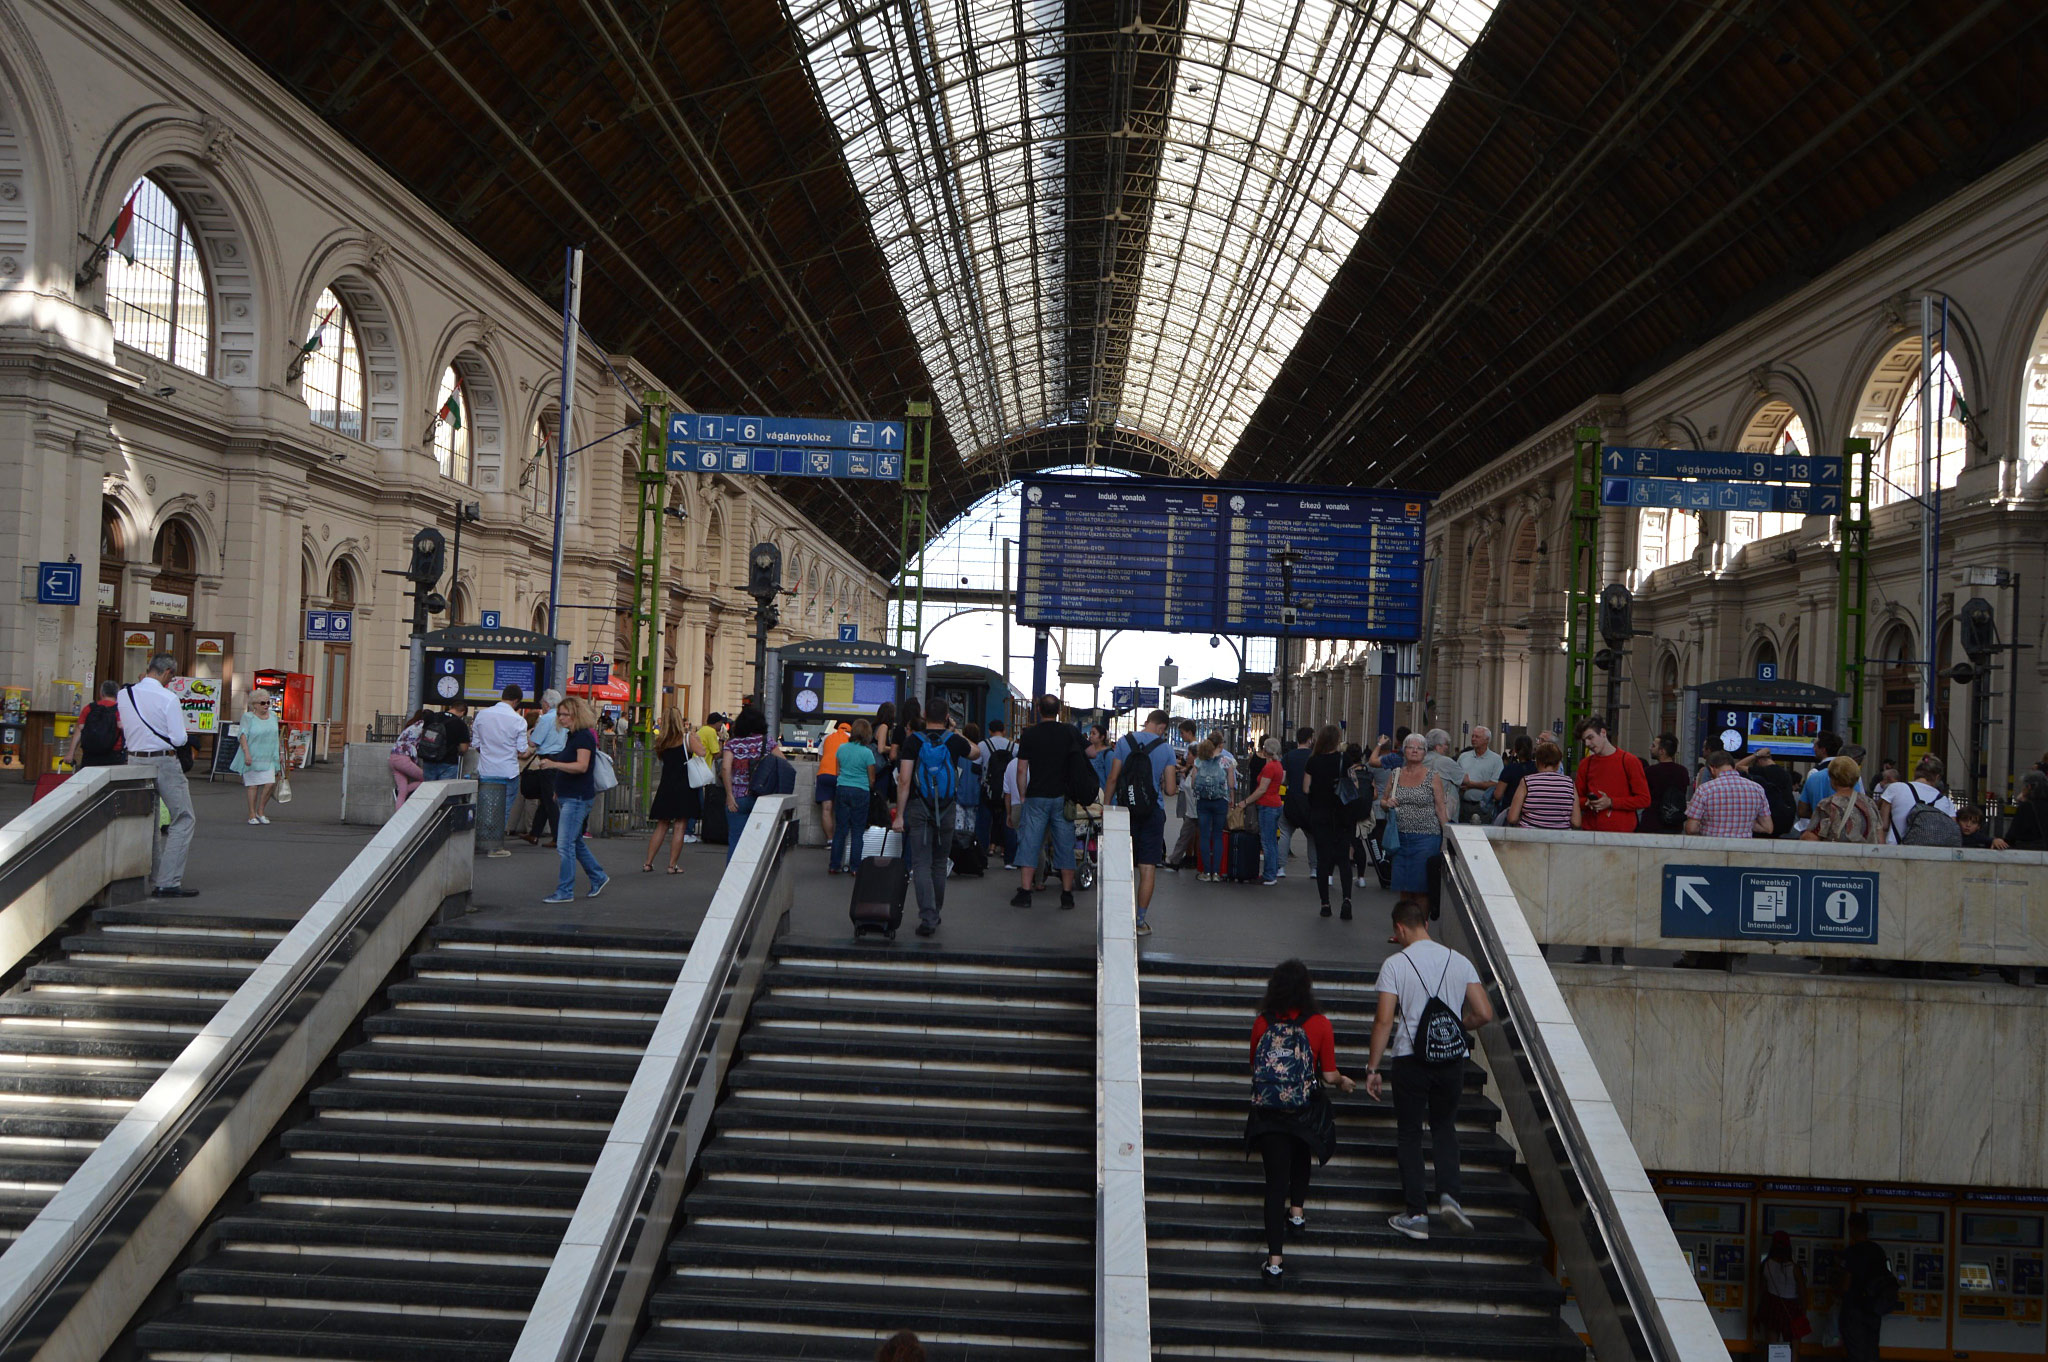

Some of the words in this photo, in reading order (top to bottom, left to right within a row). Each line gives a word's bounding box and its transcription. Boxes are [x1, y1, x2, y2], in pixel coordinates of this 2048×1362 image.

[706, 423, 714, 437] 1
[744, 425, 756, 439] 6
[766, 431, 832, 443] vágányokhoz
[1676, 465, 1743, 476] vágányokhoz
[1753, 462, 1764, 476] 9
[1789, 464, 1808, 478] 13
[1098, 492, 1118, 500] Induló
[1122, 494, 1146, 502] vonatok
[1300, 500, 1321, 509] Érkező
[486, 615, 495, 626] 6
[844, 628, 852, 639] 7
[444, 659, 455, 673] 6
[1762, 667, 1772, 678] 8
[803, 672, 814, 687] 7
[1727, 712, 1737, 727] 8
[1127, 784, 1136, 807] SPORT
[1750, 878, 1792, 887] Nemzetközi
[1822, 881, 1864, 890] Nemzetközi
[1747, 922, 1792, 931] International
[1819, 924, 1864, 934] International
